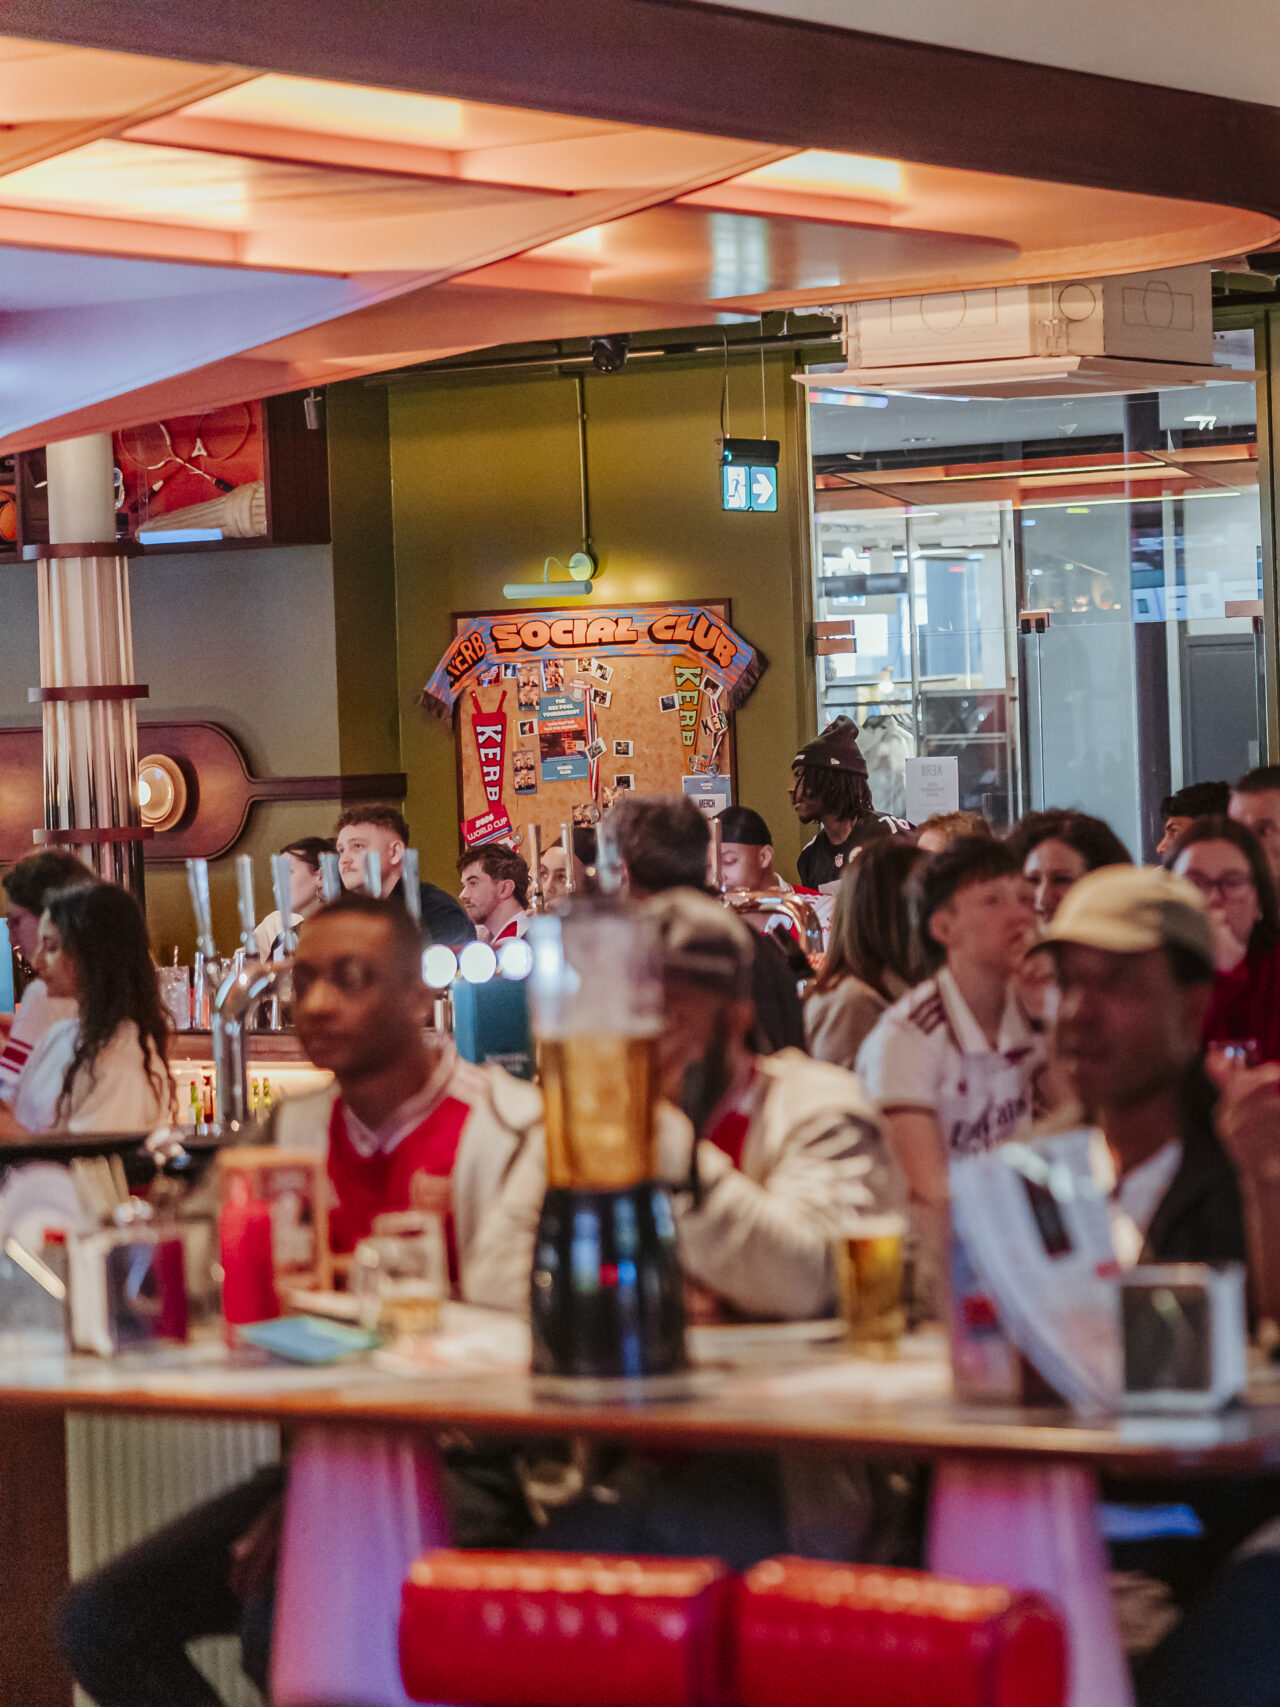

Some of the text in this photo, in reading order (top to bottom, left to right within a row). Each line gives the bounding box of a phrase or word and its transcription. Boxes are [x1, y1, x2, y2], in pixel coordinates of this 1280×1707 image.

[491, 617, 638, 653] SOCIAL
[647, 612, 738, 668] CLUB
[675, 667, 702, 746] KERB
[476, 724, 502, 801] KERB
[467, 823, 493, 841] WORLD
[493, 817, 508, 829] CUP
